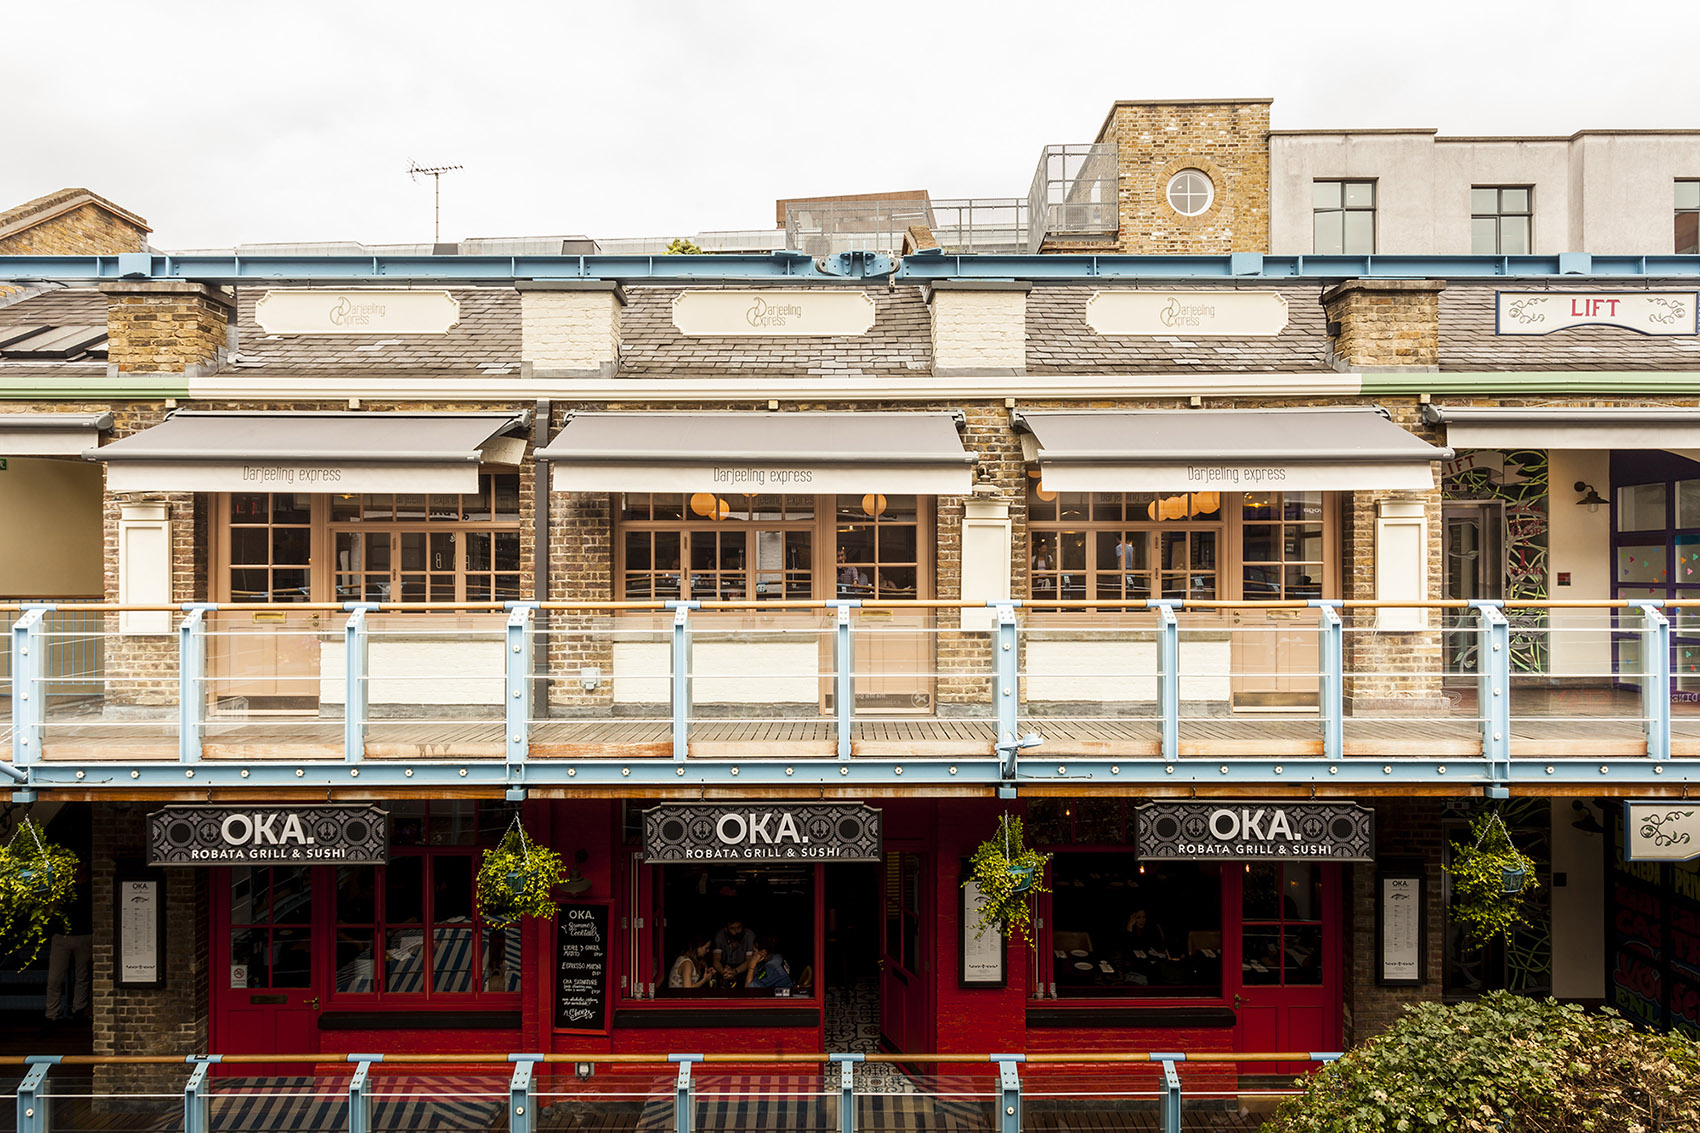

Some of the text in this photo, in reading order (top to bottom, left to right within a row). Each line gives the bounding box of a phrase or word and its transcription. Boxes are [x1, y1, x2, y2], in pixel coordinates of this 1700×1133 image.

[337, 296, 386, 318] Darjeeling
[753, 296, 802, 318] Darjeeling
[1166, 296, 1216, 318] Darjeeling
[1571, 298, 1621, 317] LIFT
[243, 465, 342, 484] Darjeeling express
[1187, 465, 1286, 484] Darjeeling express
[1442, 454, 1475, 476] IFT
[713, 466, 813, 485] Darjeeling express
[1509, 567, 1543, 575] FLOOR
[221, 813, 315, 846] OKA.
[716, 813, 809, 845] OKA.
[1209, 809, 1302, 841] OKA.
[192, 848, 345, 859] ROBATA GRILL & SUSHI
[686, 848, 840, 858] ROBATA GRILL & SUSHI
[1178, 844, 1332, 854] ROBATA GRILL & SUSHI
[568, 910, 595, 920] OKA.
